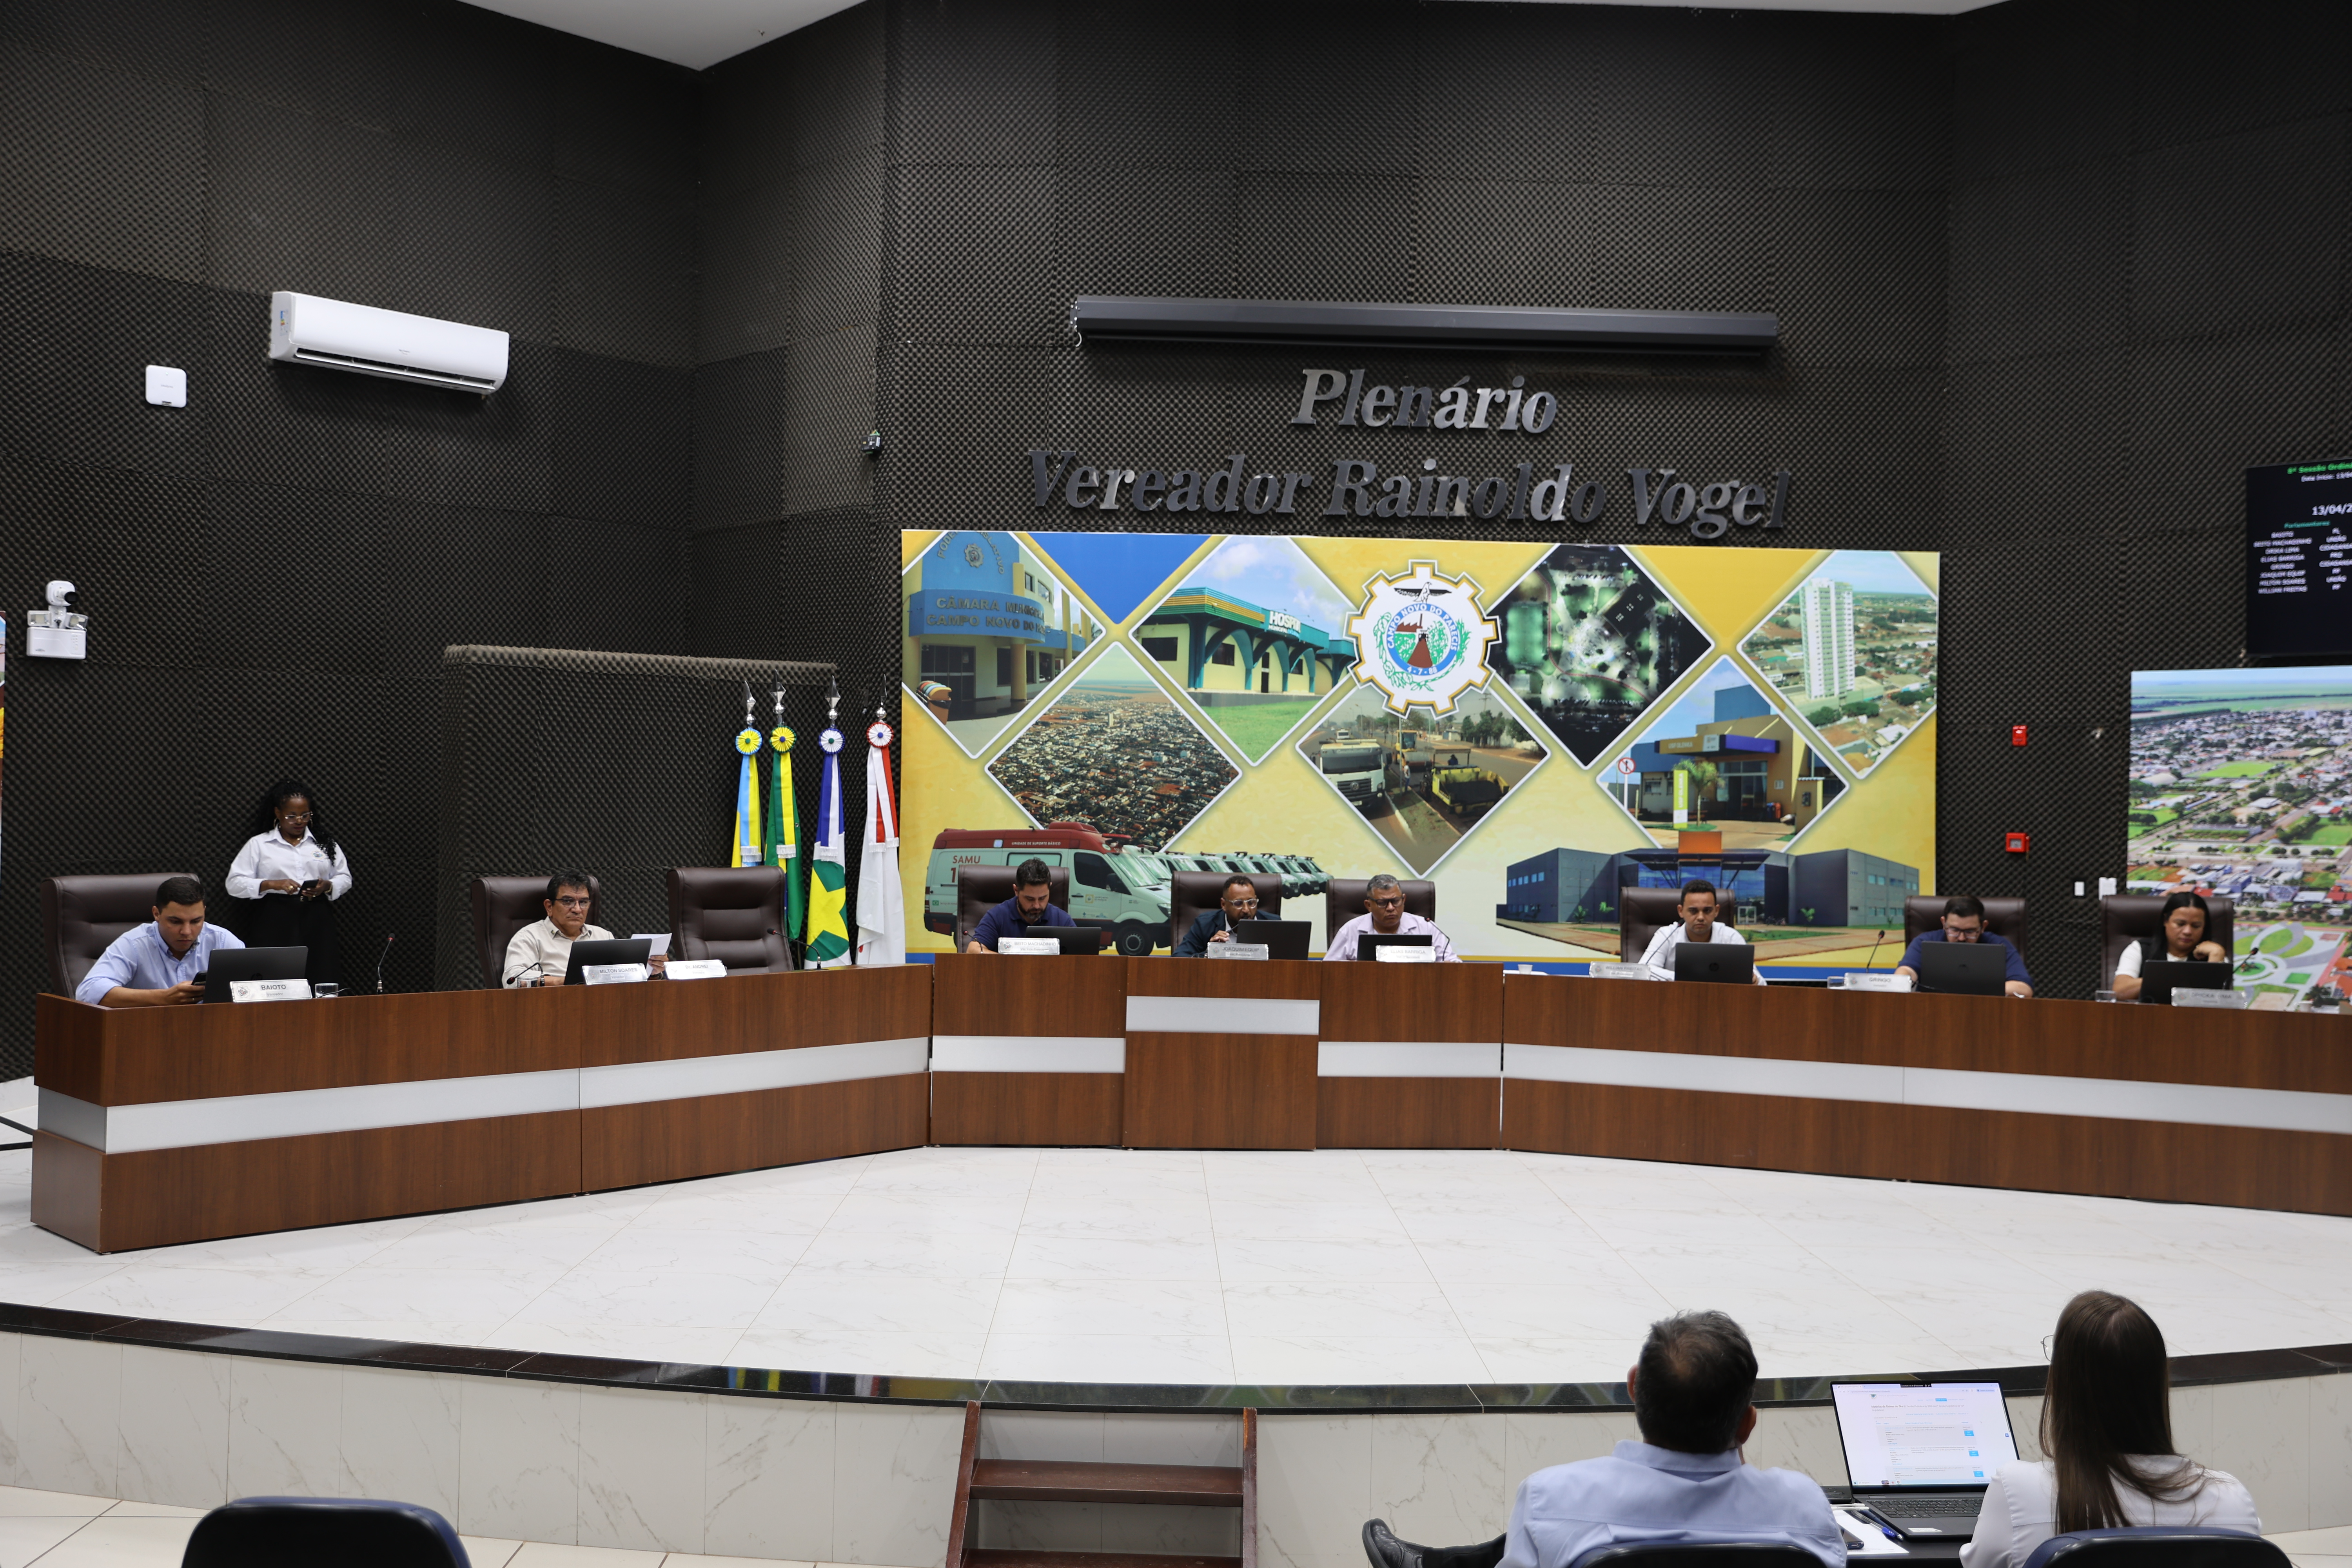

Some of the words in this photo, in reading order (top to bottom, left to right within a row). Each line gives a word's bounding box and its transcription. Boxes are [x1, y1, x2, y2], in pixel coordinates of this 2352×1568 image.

[1291, 368, 1557, 434] Plenário
[1026, 450, 1314, 515] Vereador
[1322, 459, 1605, 523] Rainoldo
[1627, 467, 1791, 539] Vogel
[936, 596, 1000, 611] CÂMARA
[926, 614, 980, 626] CAMPO
[986, 616, 1020, 629] NOVO
[1024, 621, 1034, 631] DO
[1388, 615, 1401, 648] CAMPO
[1401, 604, 1427, 617] NOVO
[1430, 606, 1442, 615] DO
[1443, 614, 1458, 651] PARECIS
[953, 855, 981, 864] SAMU
